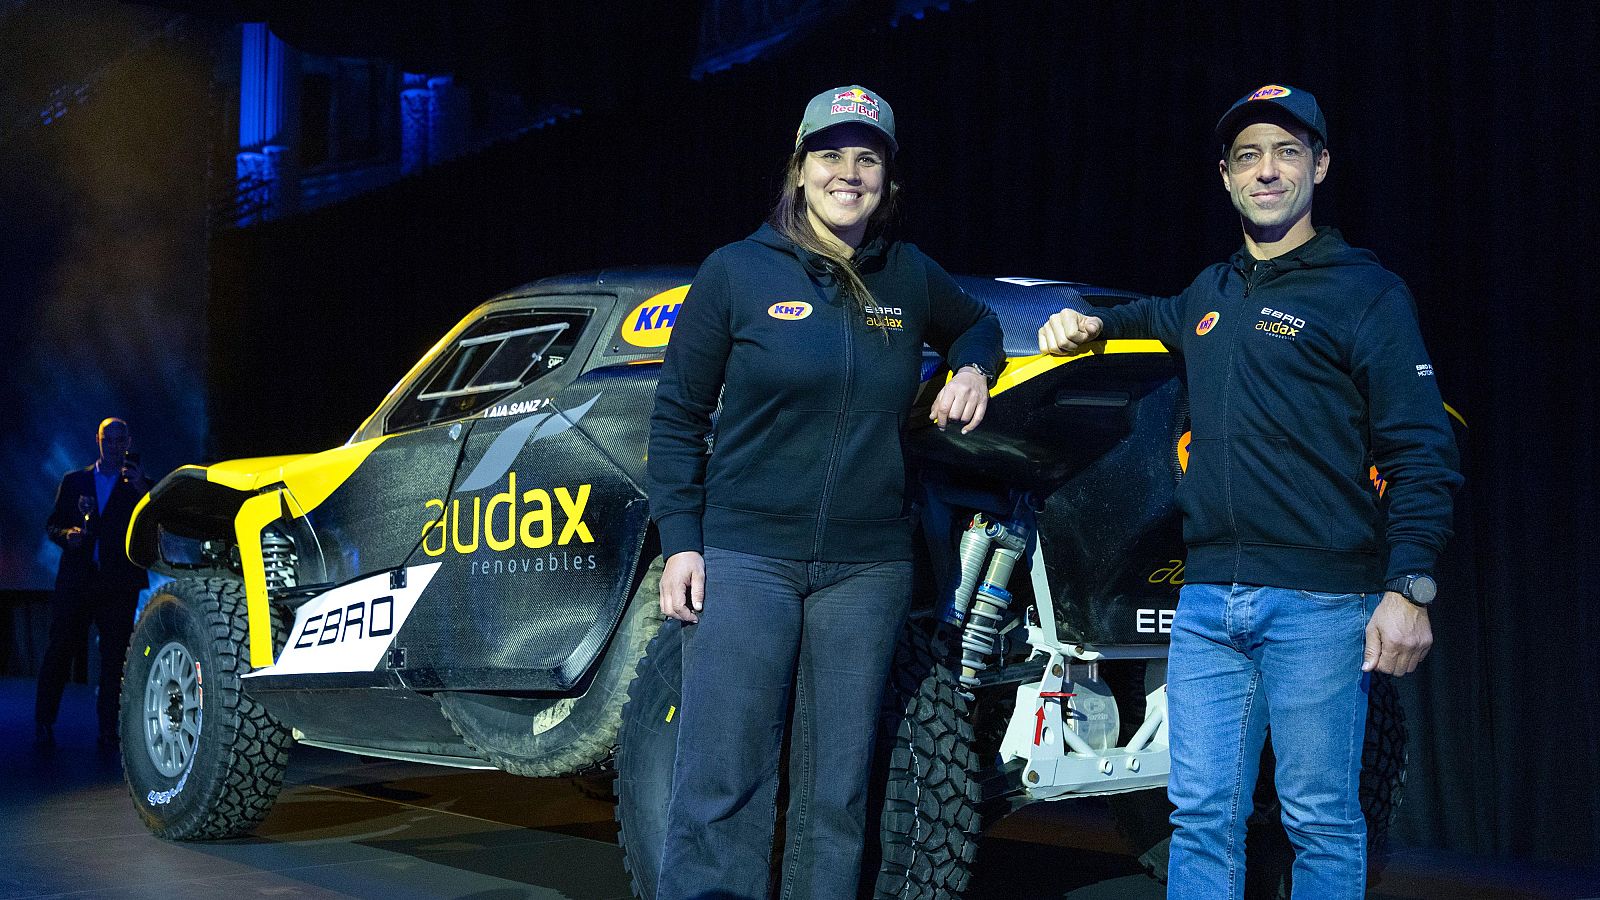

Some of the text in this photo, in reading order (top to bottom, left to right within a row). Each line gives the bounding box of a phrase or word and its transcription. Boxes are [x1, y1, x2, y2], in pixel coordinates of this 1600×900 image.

[831, 103, 879, 121] Red Bull
[1255, 320, 1299, 336] audax
[1261, 307, 1305, 328] EBRO
[509, 400, 541, 415] SANZ
[421, 472, 594, 556] audax
[471, 552, 597, 576] renovables
[294, 596, 393, 649] EBRO
